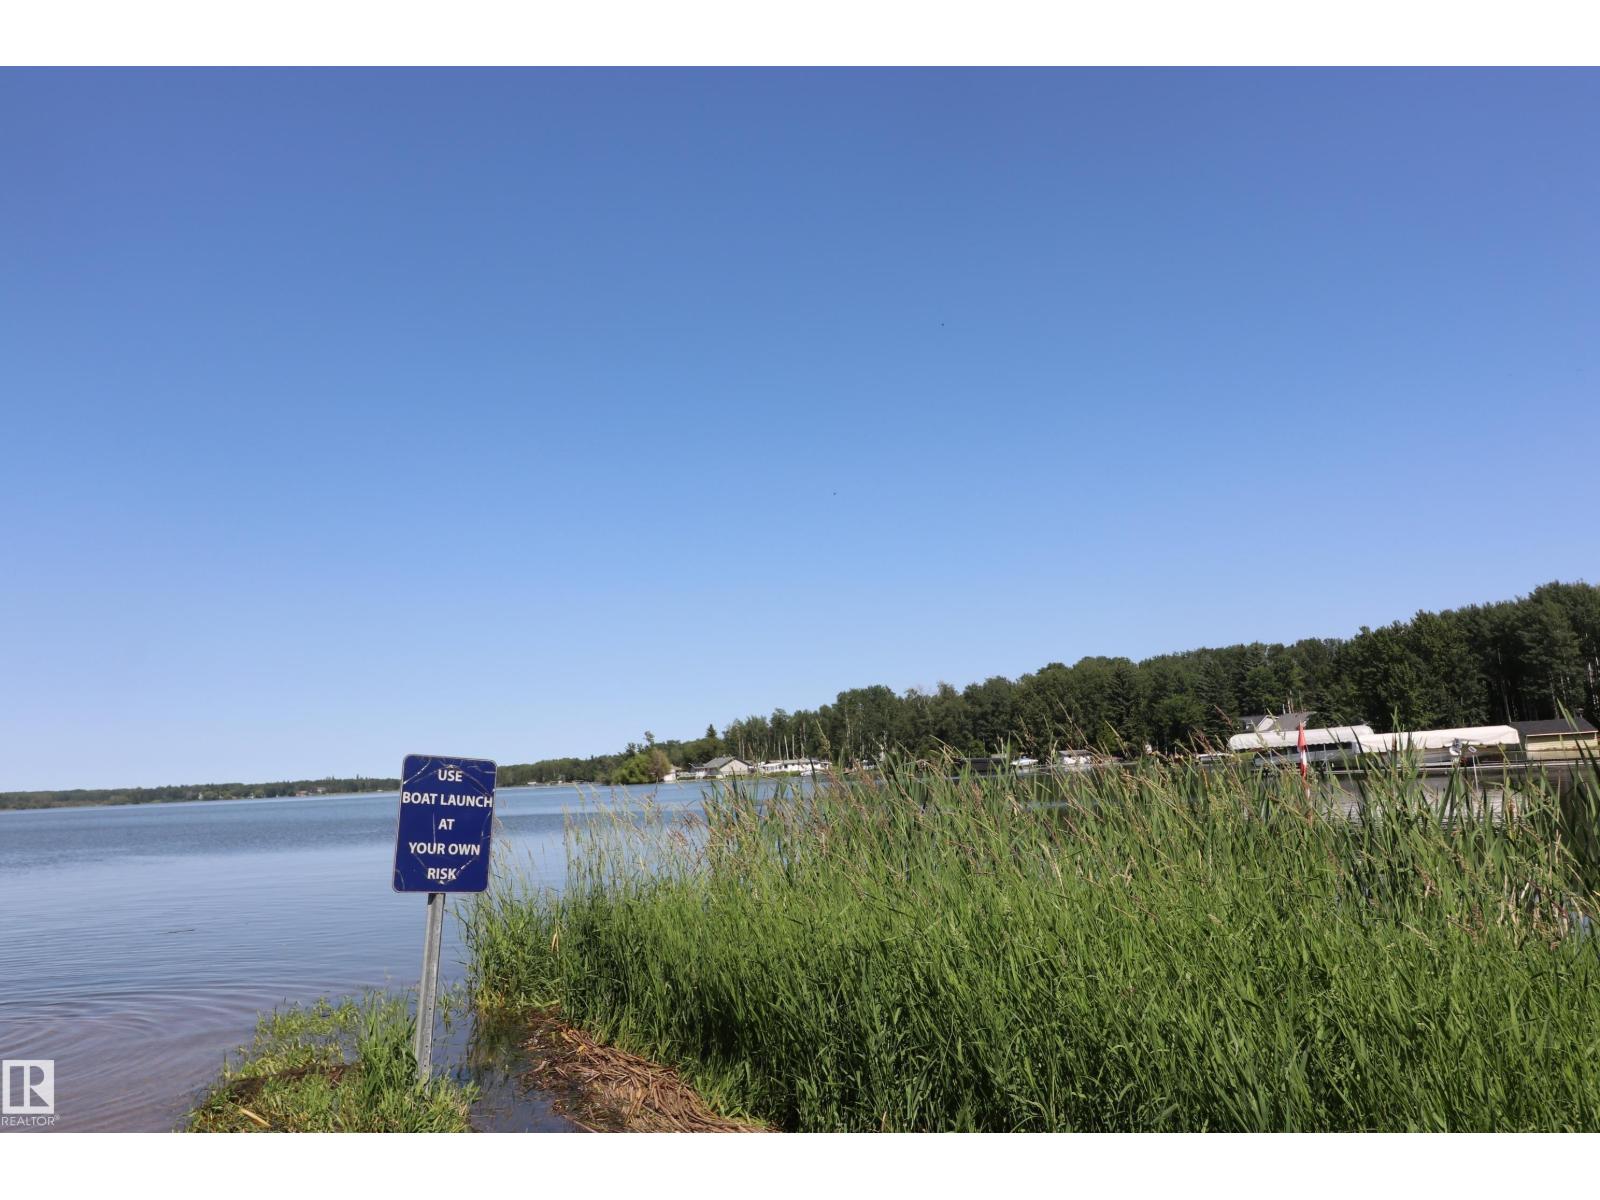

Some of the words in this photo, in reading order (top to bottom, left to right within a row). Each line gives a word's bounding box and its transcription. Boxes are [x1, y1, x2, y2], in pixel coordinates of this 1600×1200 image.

[438, 769, 463, 782] USE
[402, 791, 438, 805] BOAT
[440, 794, 493, 808] LAUNCH
[438, 818, 455, 830] AT
[408, 842, 446, 855] YOUR
[448, 843, 481, 856] OWN
[427, 867, 457, 880] RISK
